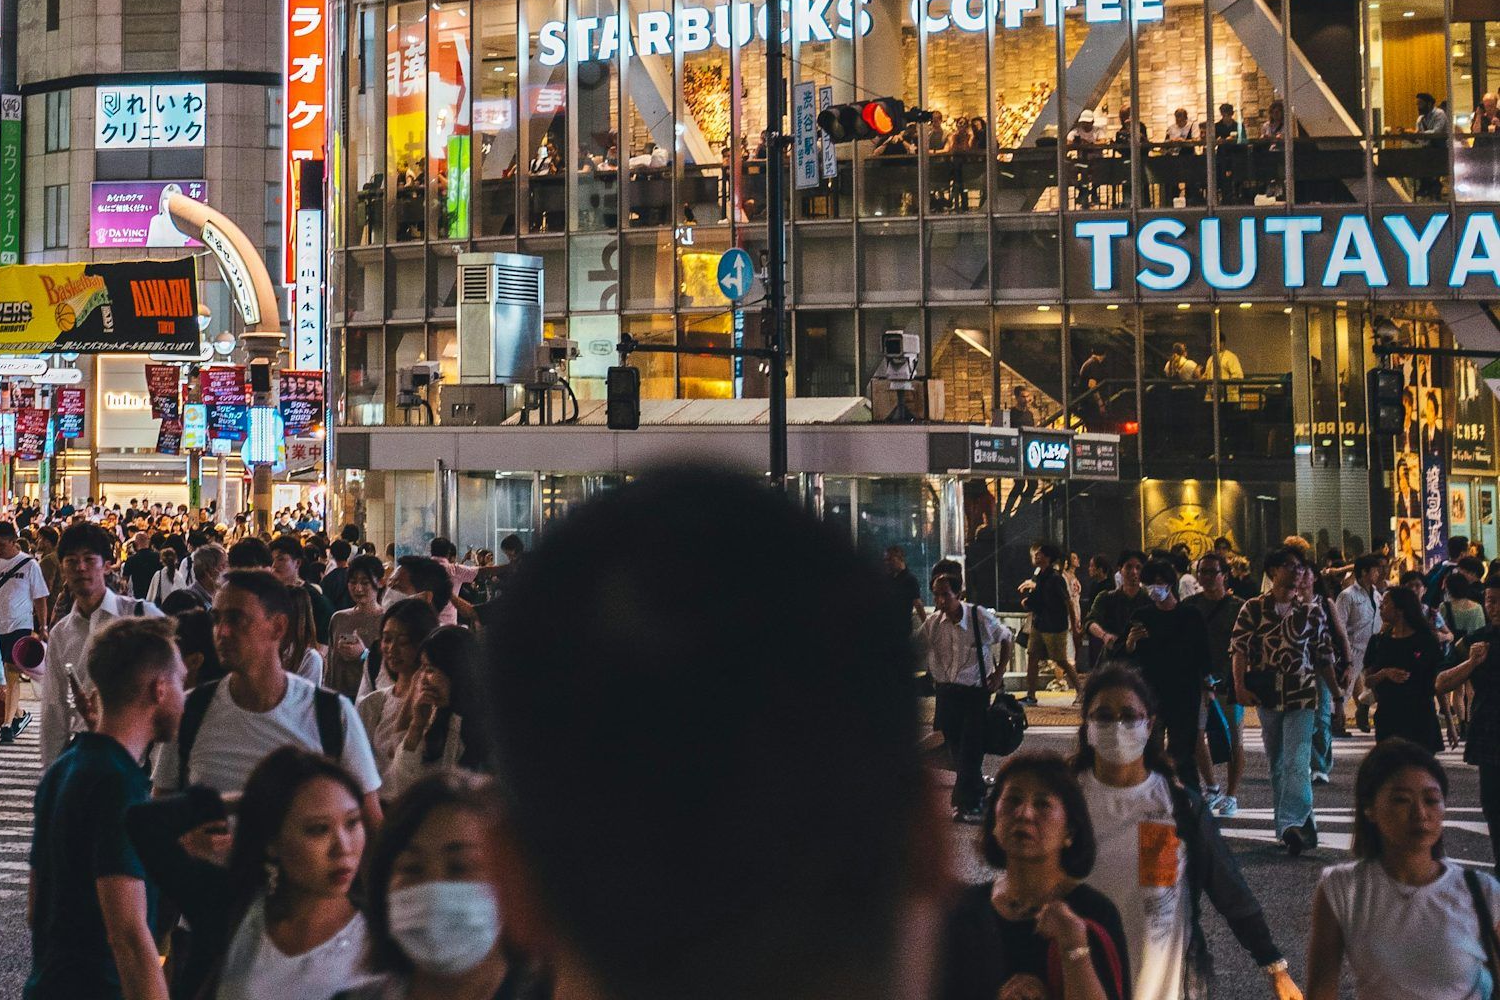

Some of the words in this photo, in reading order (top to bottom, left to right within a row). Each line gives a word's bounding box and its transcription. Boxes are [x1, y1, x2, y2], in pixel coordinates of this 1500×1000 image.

[126, 92, 204, 116] れいわ
[100, 120, 203, 144] クリニック
[802, 89, 816, 180] 渋谷駅前
[108, 229, 122, 238] DA
[123, 229, 148, 238] VINCI
[1074, 211, 1500, 292] TSUTAYA
[40, 273, 104, 305] Basketball
[130, 278, 193, 318] ALVARK
[0, 324, 25, 334] SHIBUYA
